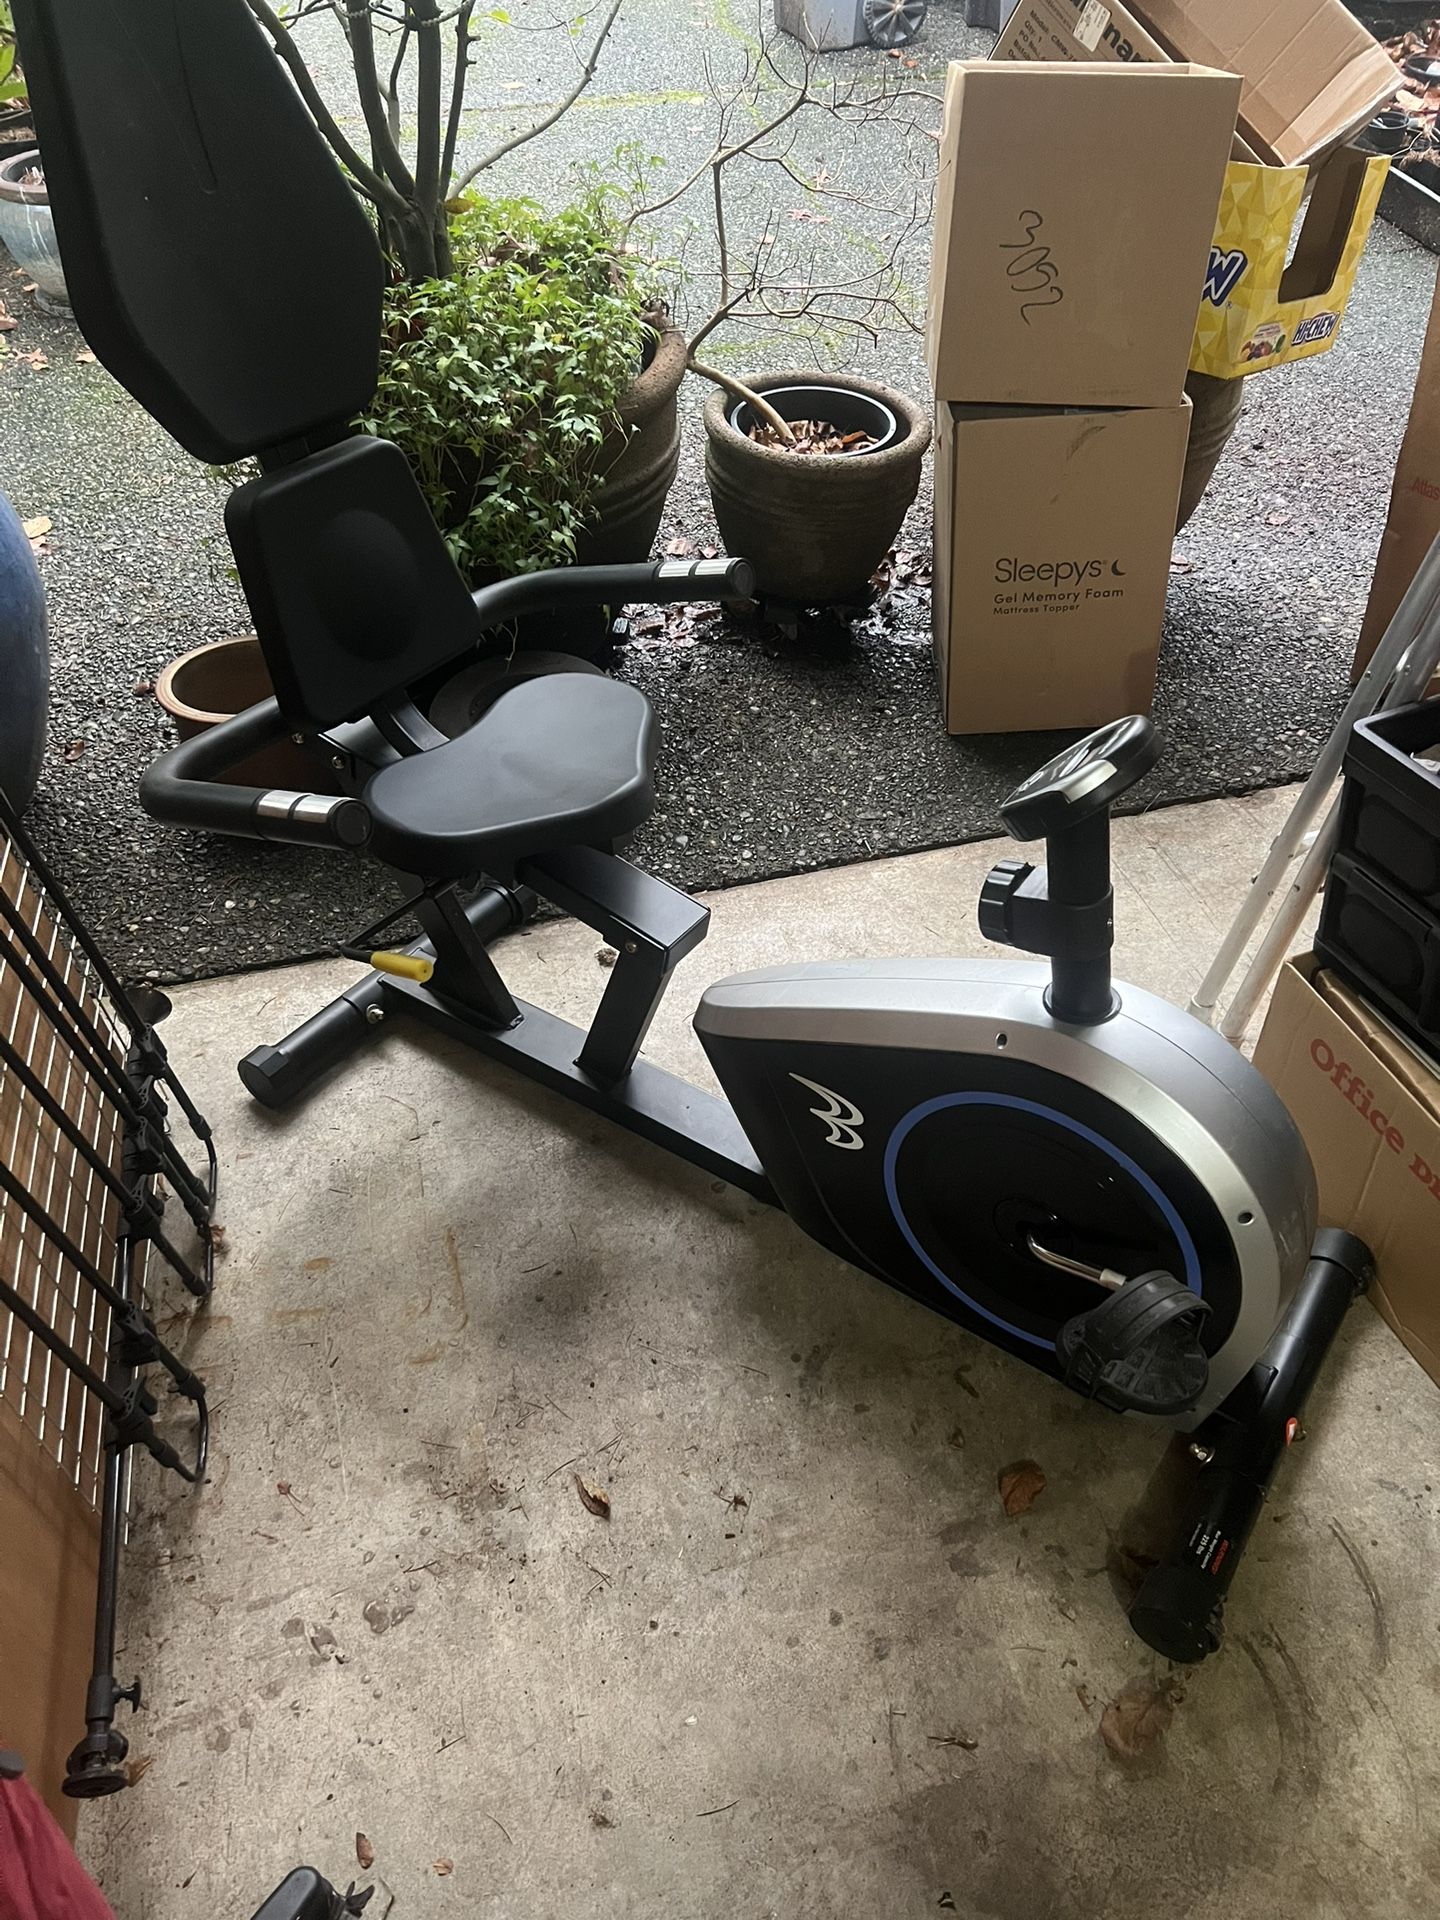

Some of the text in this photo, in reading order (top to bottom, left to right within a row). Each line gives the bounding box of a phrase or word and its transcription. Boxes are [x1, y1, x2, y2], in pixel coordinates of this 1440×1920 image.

[994, 588, 1124, 604] Gel Memory Foam
[993, 604, 1080, 615] Mattress Topper
[1310, 1038, 1405, 1155] Office
